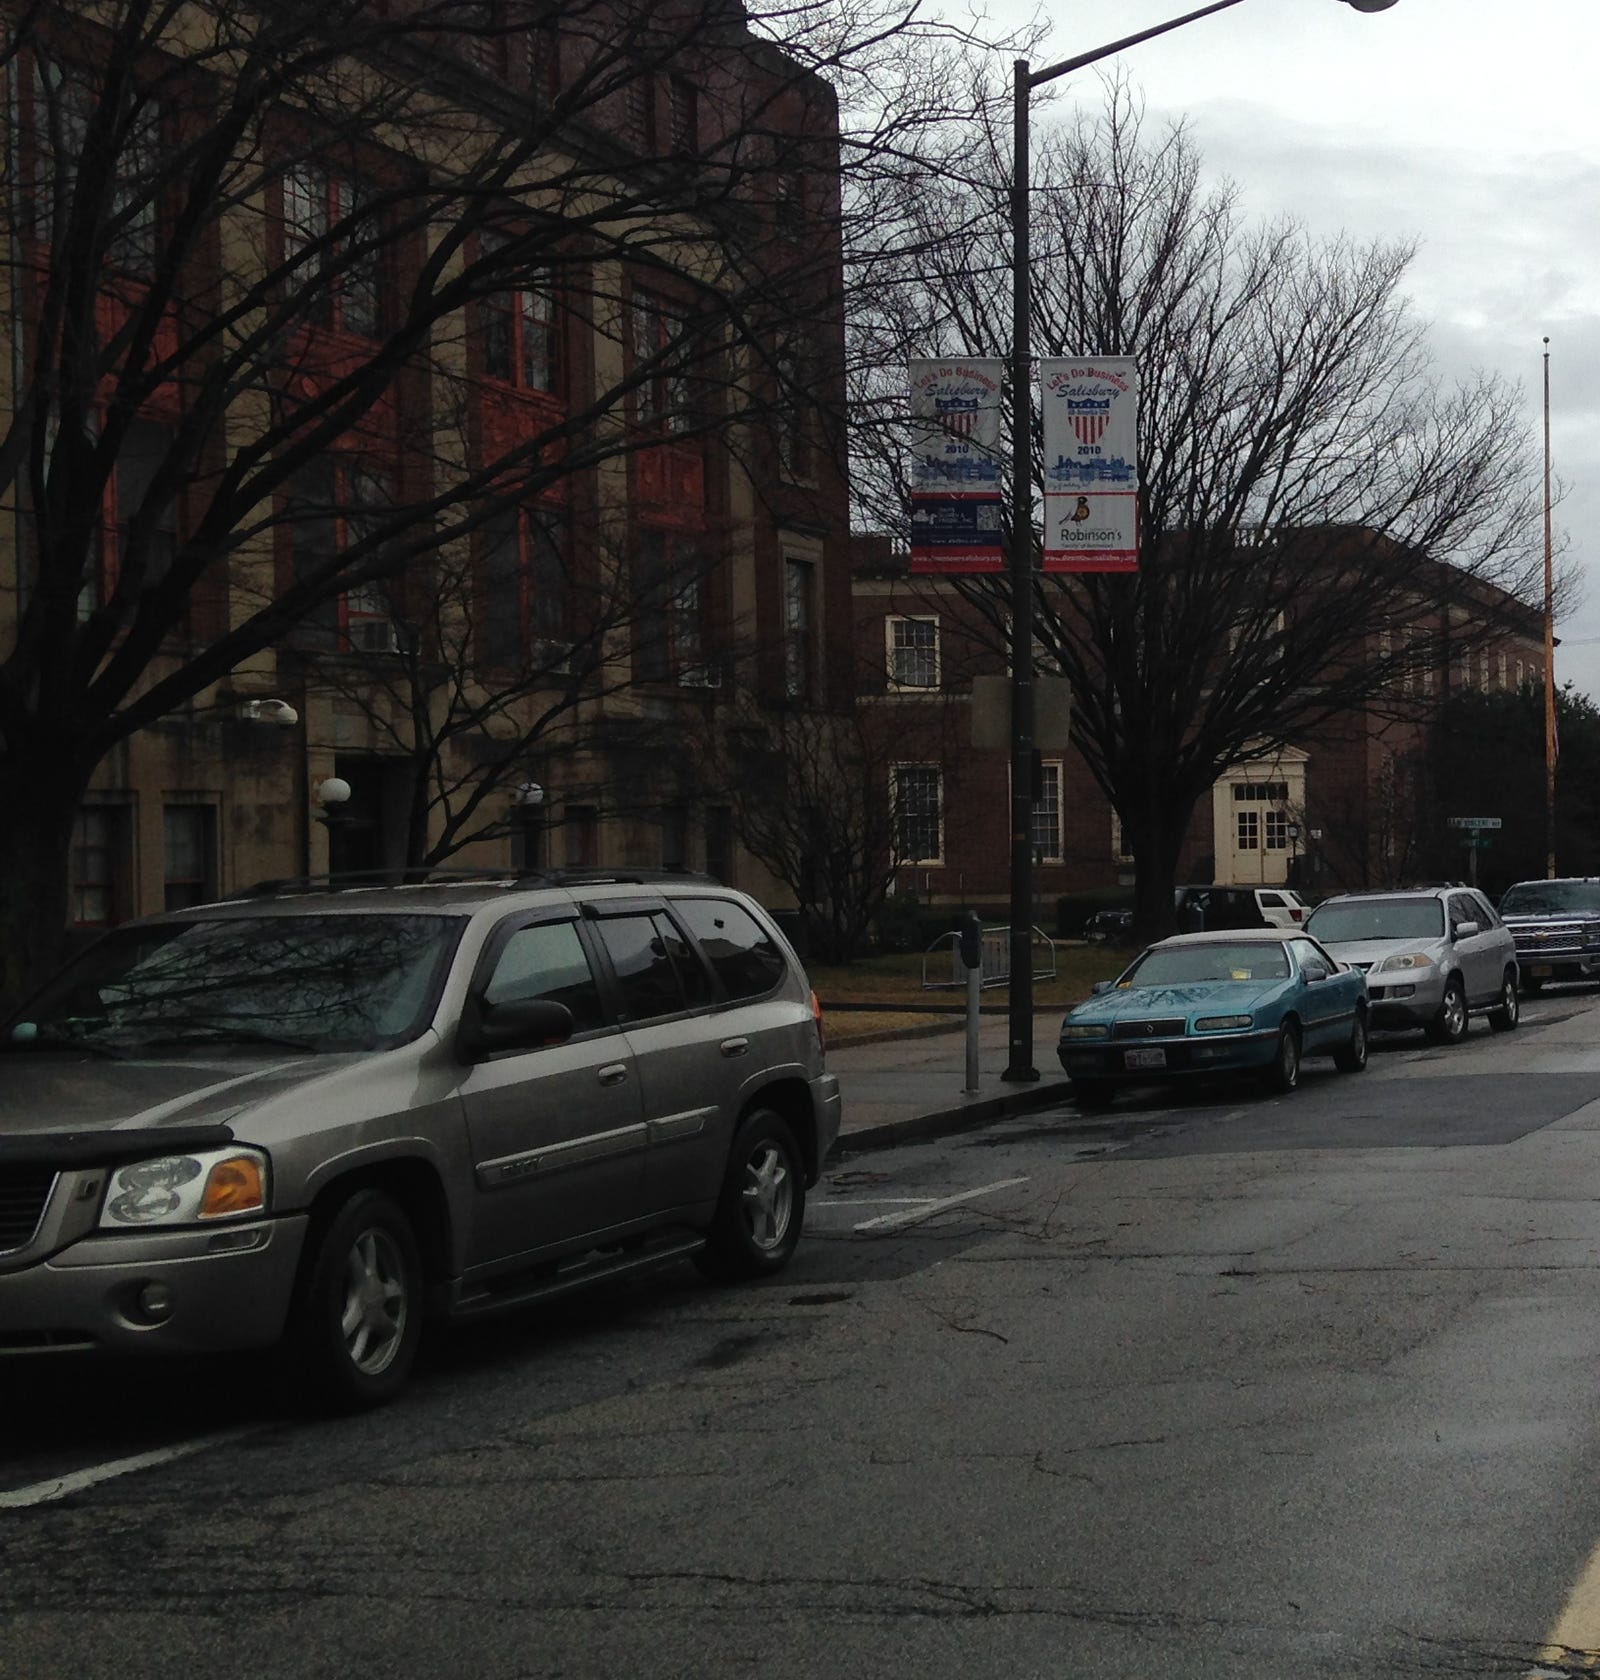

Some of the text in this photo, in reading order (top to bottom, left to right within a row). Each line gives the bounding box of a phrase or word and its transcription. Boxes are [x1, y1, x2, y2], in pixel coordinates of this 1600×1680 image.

[940, 367, 953, 377] Do
[956, 366, 997, 391] Business
[1046, 367, 1129, 392] Let's Do Business
[925, 383, 989, 399] Salisbury
[1056, 384, 1120, 399] Salisbury
[945, 444, 969, 453] 2010
[1077, 446, 1101, 455] 2010
[1061, 528, 1122, 541] Robinson's
